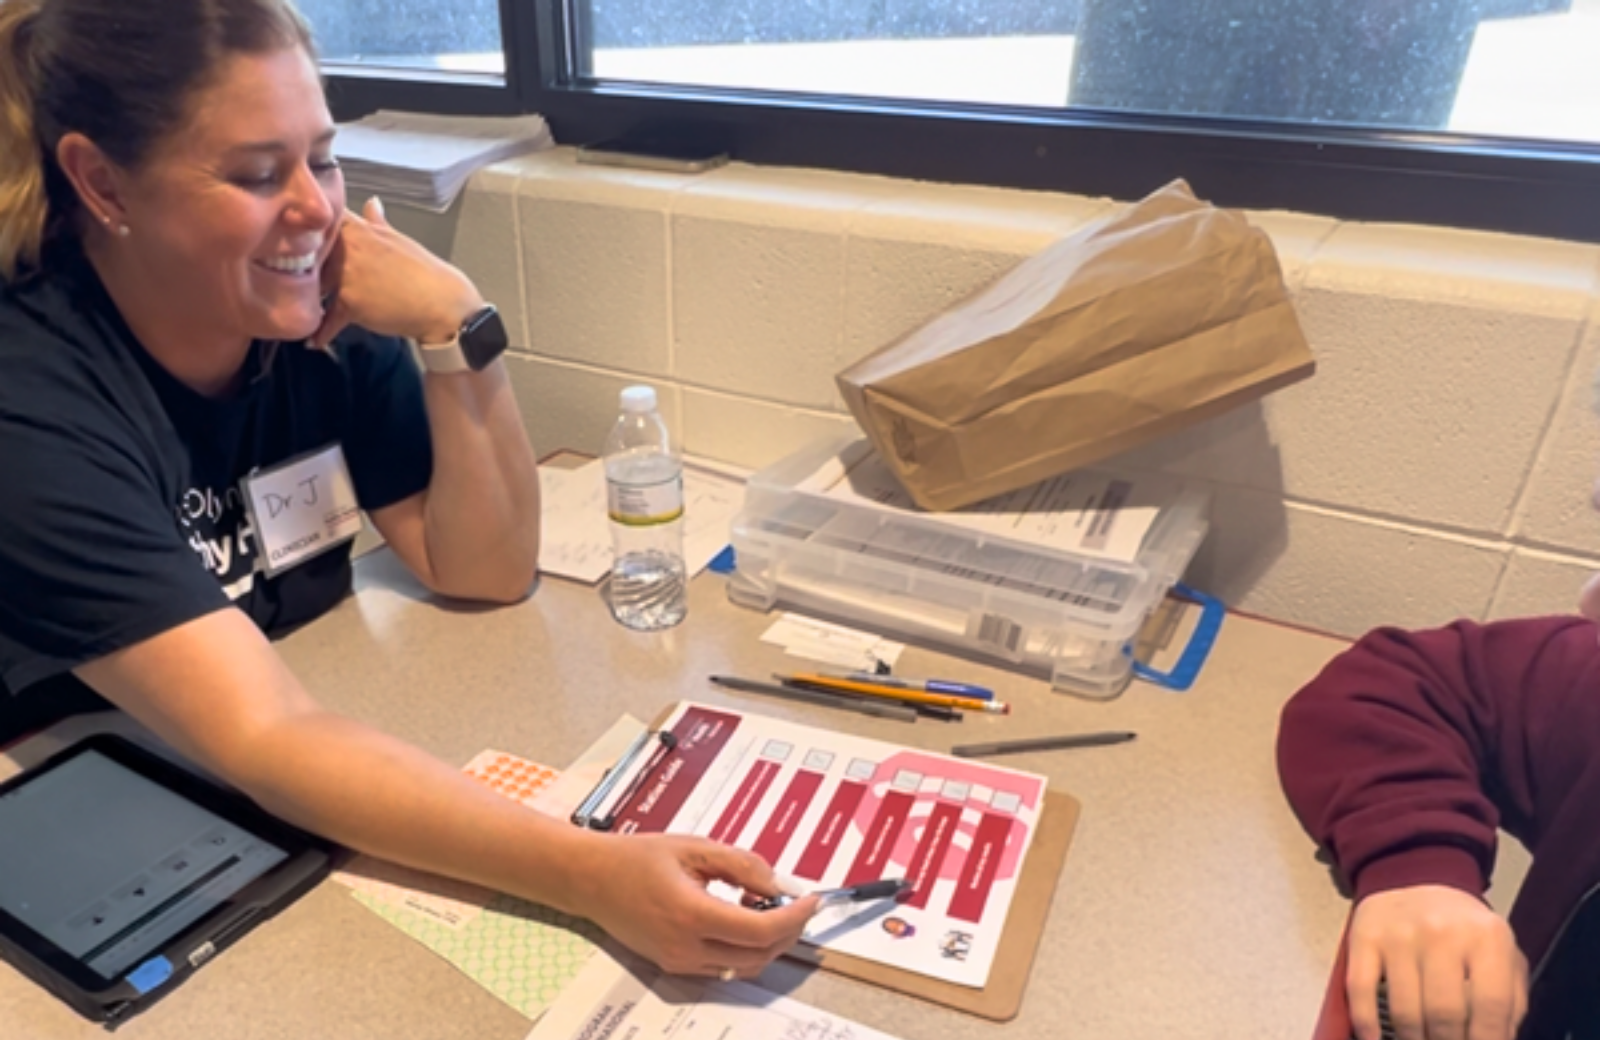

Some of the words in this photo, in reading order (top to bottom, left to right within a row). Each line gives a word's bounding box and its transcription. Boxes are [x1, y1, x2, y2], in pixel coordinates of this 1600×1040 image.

[262, 492, 293, 520] Dr
[298, 474, 319, 506] J
[272, 532, 321, 562] CLINICIAN
[637, 781, 668, 814] Station
[659, 757, 684, 783] Guide
